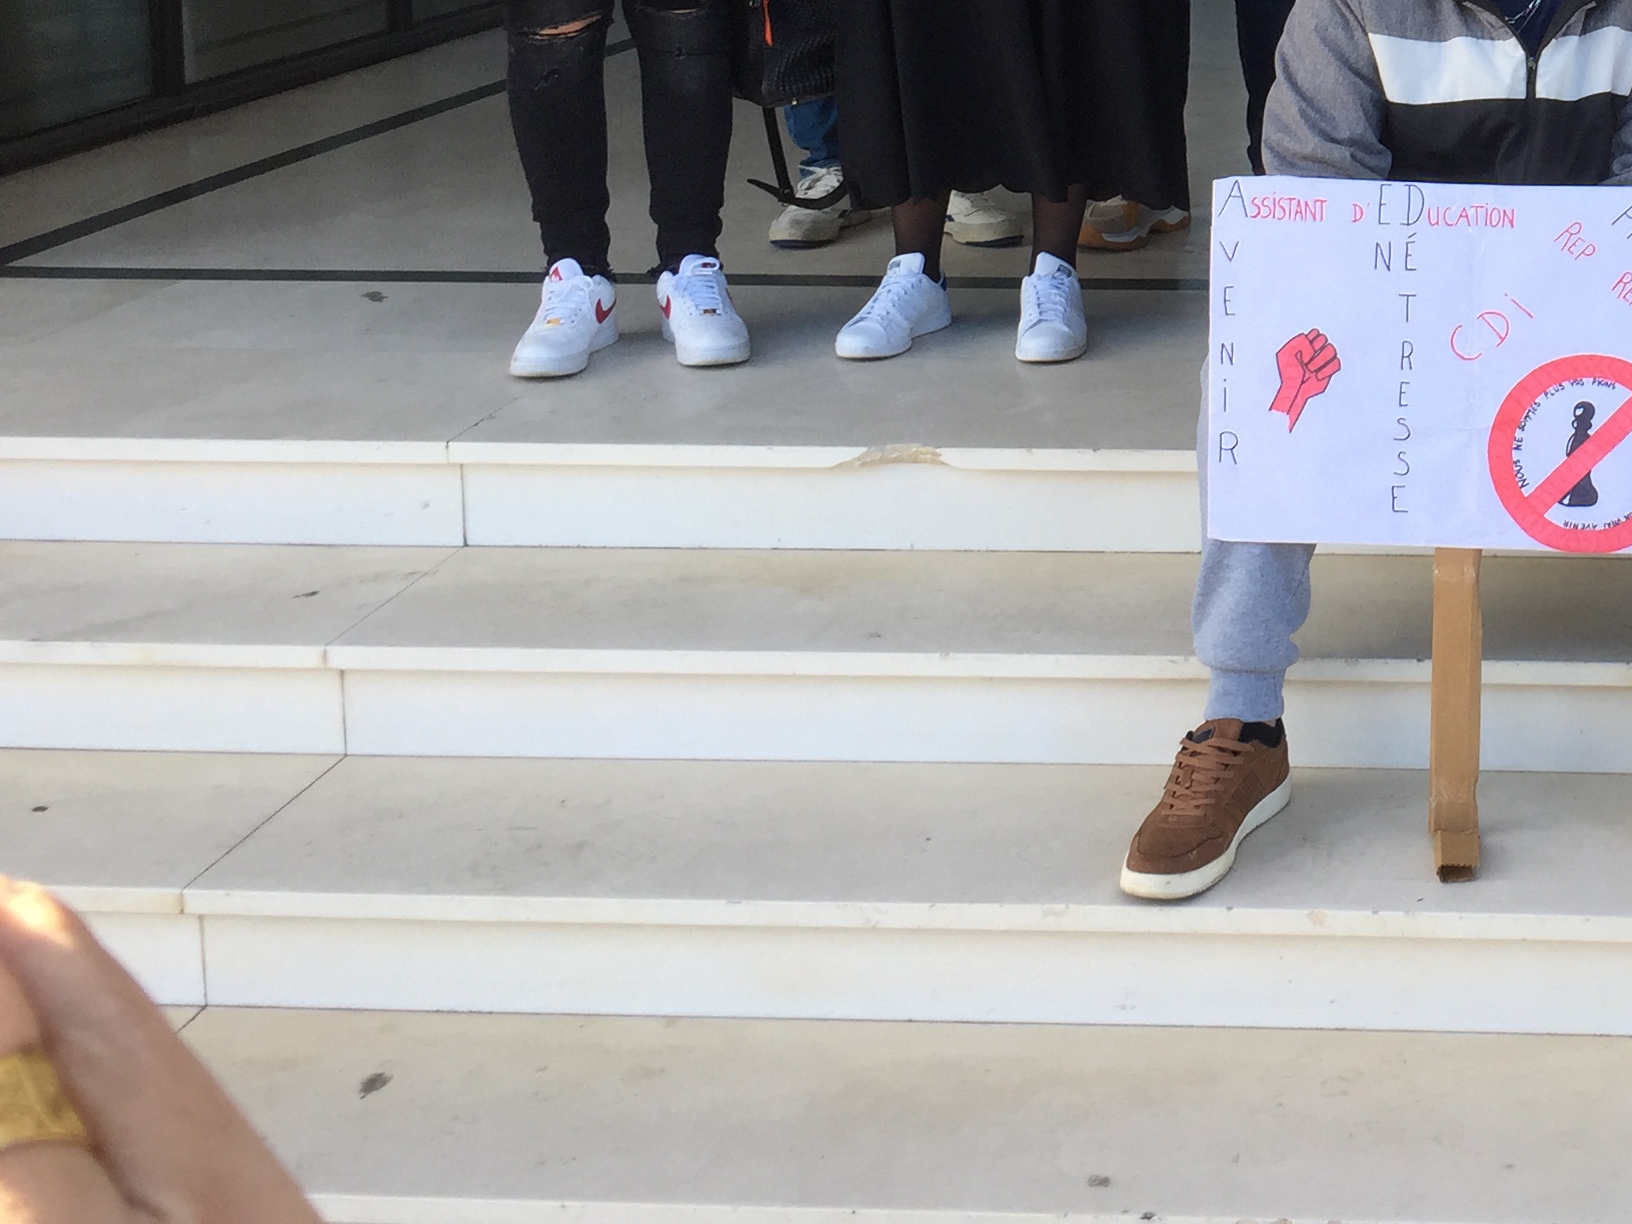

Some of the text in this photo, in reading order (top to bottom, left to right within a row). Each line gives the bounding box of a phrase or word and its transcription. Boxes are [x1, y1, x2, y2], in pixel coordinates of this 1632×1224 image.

[1543, 383, 1566, 400] PLUS
[1513, 436, 1524, 451] NE
[1512, 458, 1530, 489] NOUS
